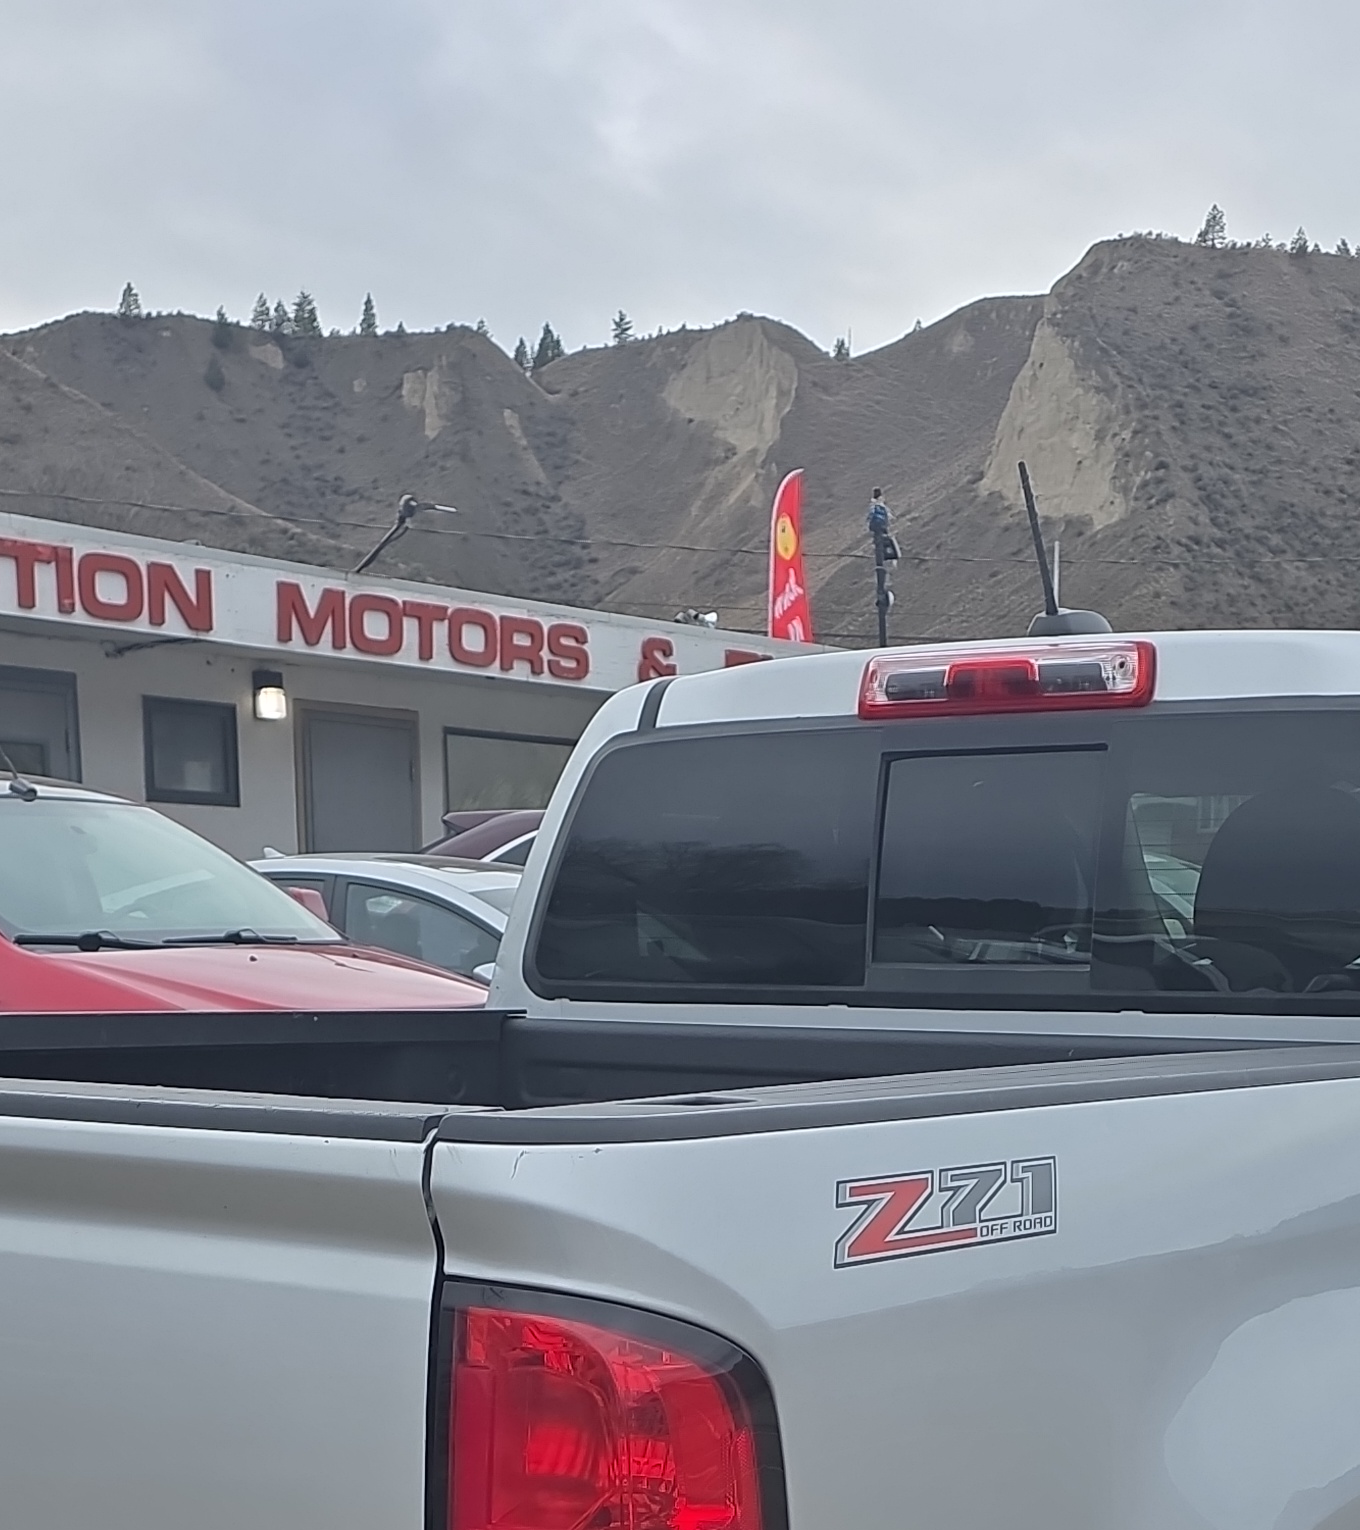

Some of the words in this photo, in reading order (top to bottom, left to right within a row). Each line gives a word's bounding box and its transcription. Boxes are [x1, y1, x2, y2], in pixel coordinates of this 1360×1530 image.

[276, 579, 591, 681] MOTORS
[833, 1154, 1058, 1269] Z71
[979, 1223, 1009, 1238] OFF
[1012, 1214, 1053, 1233] ROAD
